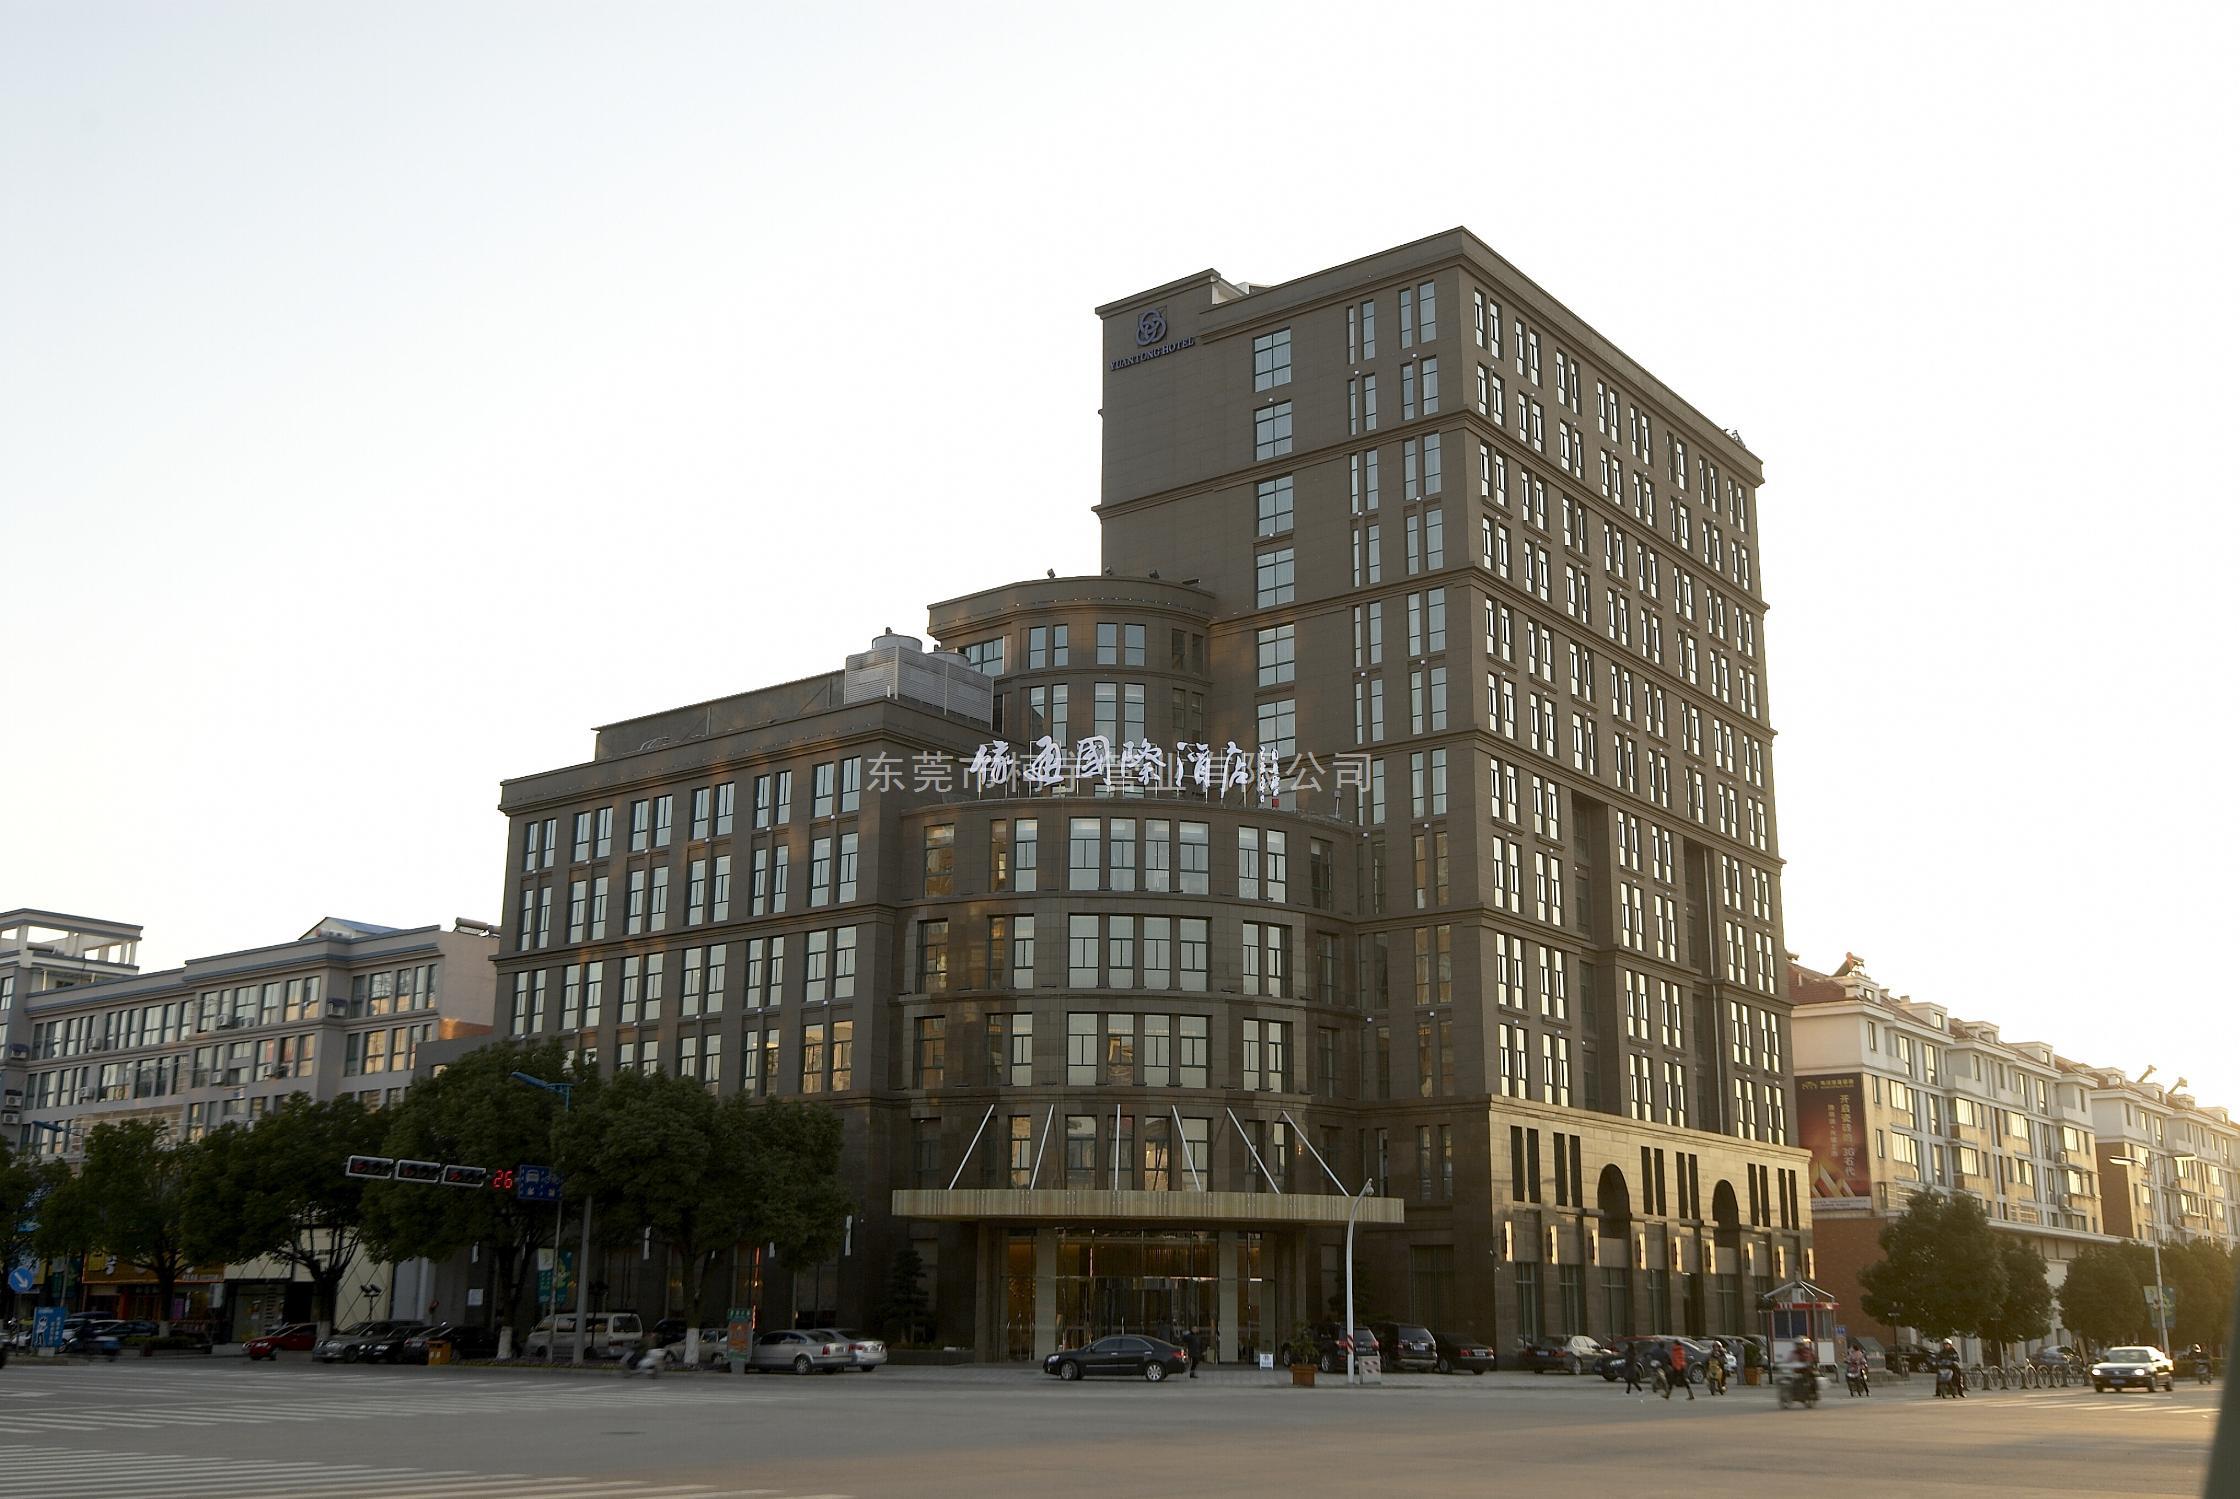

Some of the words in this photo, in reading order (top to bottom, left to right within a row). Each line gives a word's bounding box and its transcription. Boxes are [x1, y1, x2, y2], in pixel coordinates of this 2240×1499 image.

[1110, 348, 1160, 370] YUANTONG
[1162, 336, 1195, 355] HOTEL
[493, 1169, 512, 1189] 26
